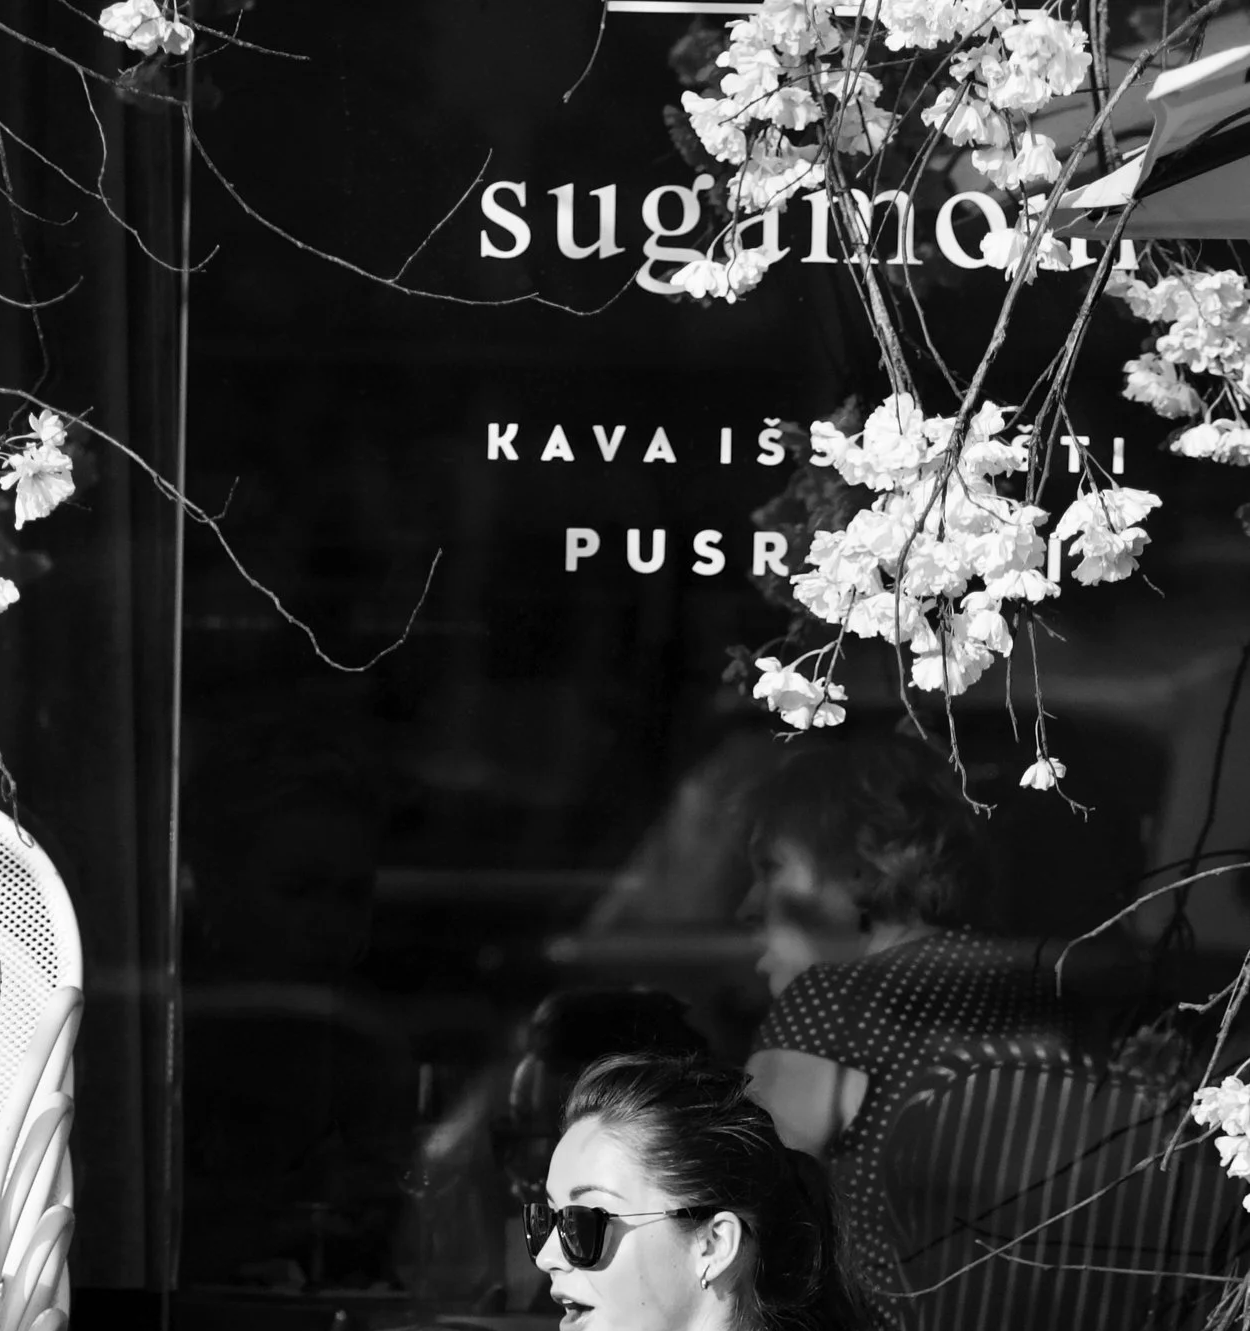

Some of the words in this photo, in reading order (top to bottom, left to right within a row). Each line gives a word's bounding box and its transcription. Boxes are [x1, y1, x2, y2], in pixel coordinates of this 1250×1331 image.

[486, 422, 678, 464] KAVA
[719, 417, 1125, 475] IŠŠTI
[565, 527, 1062, 583] PUSRI
